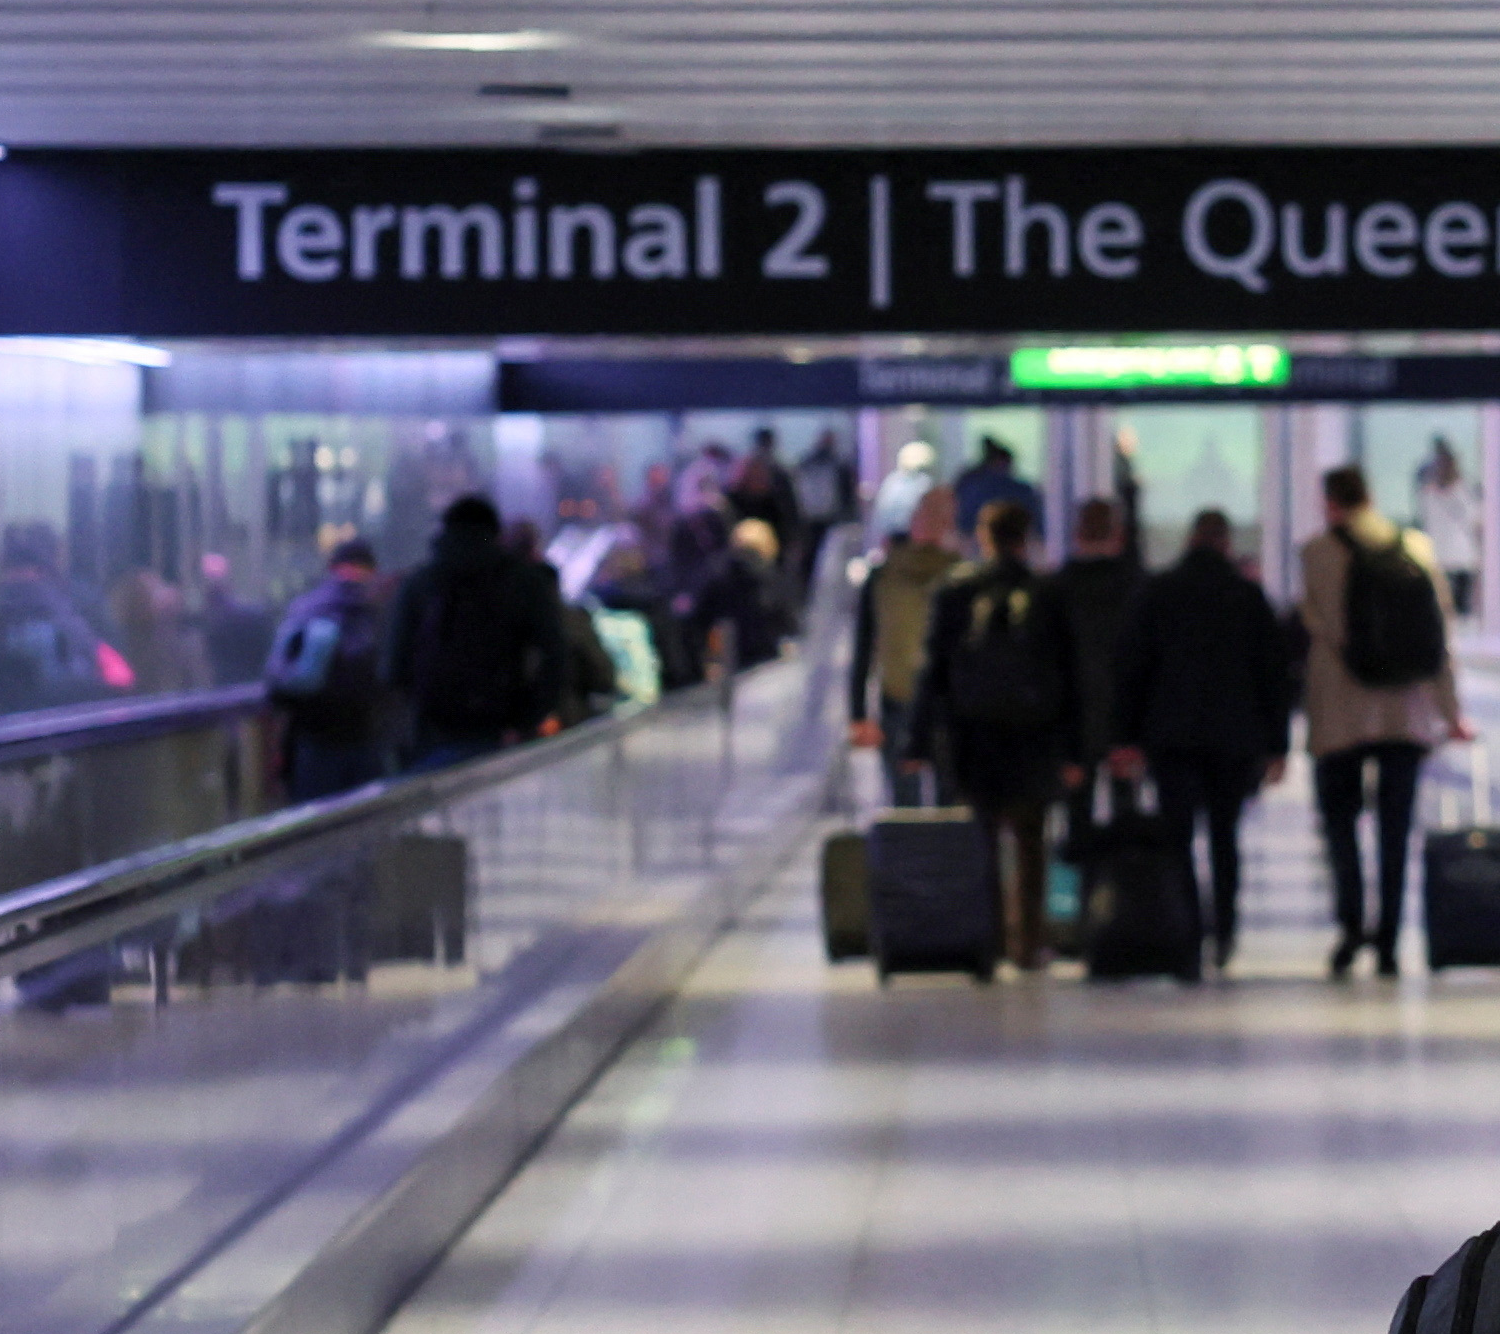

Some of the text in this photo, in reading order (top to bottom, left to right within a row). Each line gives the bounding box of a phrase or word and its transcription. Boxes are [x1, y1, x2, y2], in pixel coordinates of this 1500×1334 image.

[214, 177, 721, 279] Terminal
[764, 182, 828, 276] 2
[930, 178, 1142, 276] The
